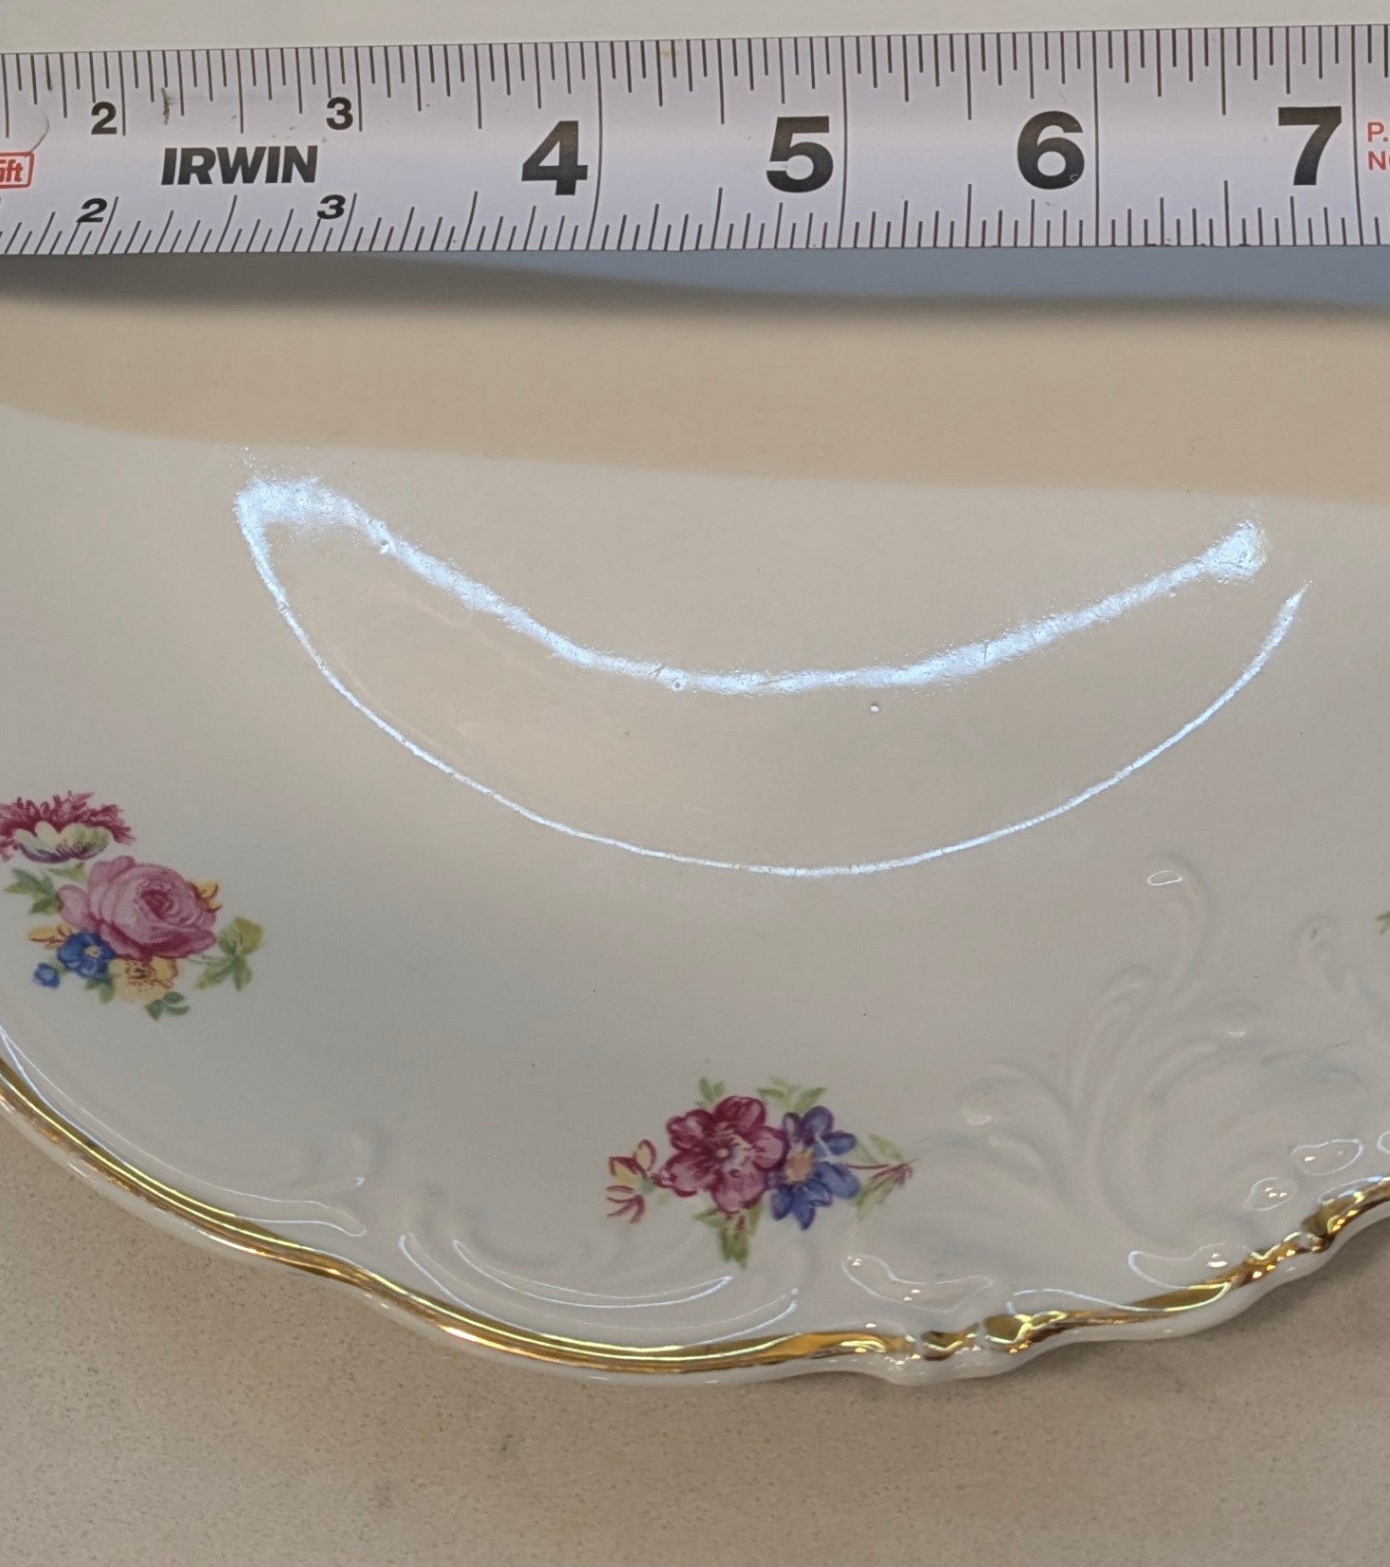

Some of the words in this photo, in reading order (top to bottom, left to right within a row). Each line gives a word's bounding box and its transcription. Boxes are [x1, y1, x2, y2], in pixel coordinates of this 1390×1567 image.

[91, 102, 117, 135] 2
[326, 97, 354, 130] 3
[161, 145, 318, 185] IRWIN
[521, 120, 589, 196] 4
[766, 115, 834, 193] 5
[1016, 110, 1085, 190] 6
[1277, 105, 1342, 186] 7
[77, 198, 108, 223] 2
[317, 194, 347, 219] 3
